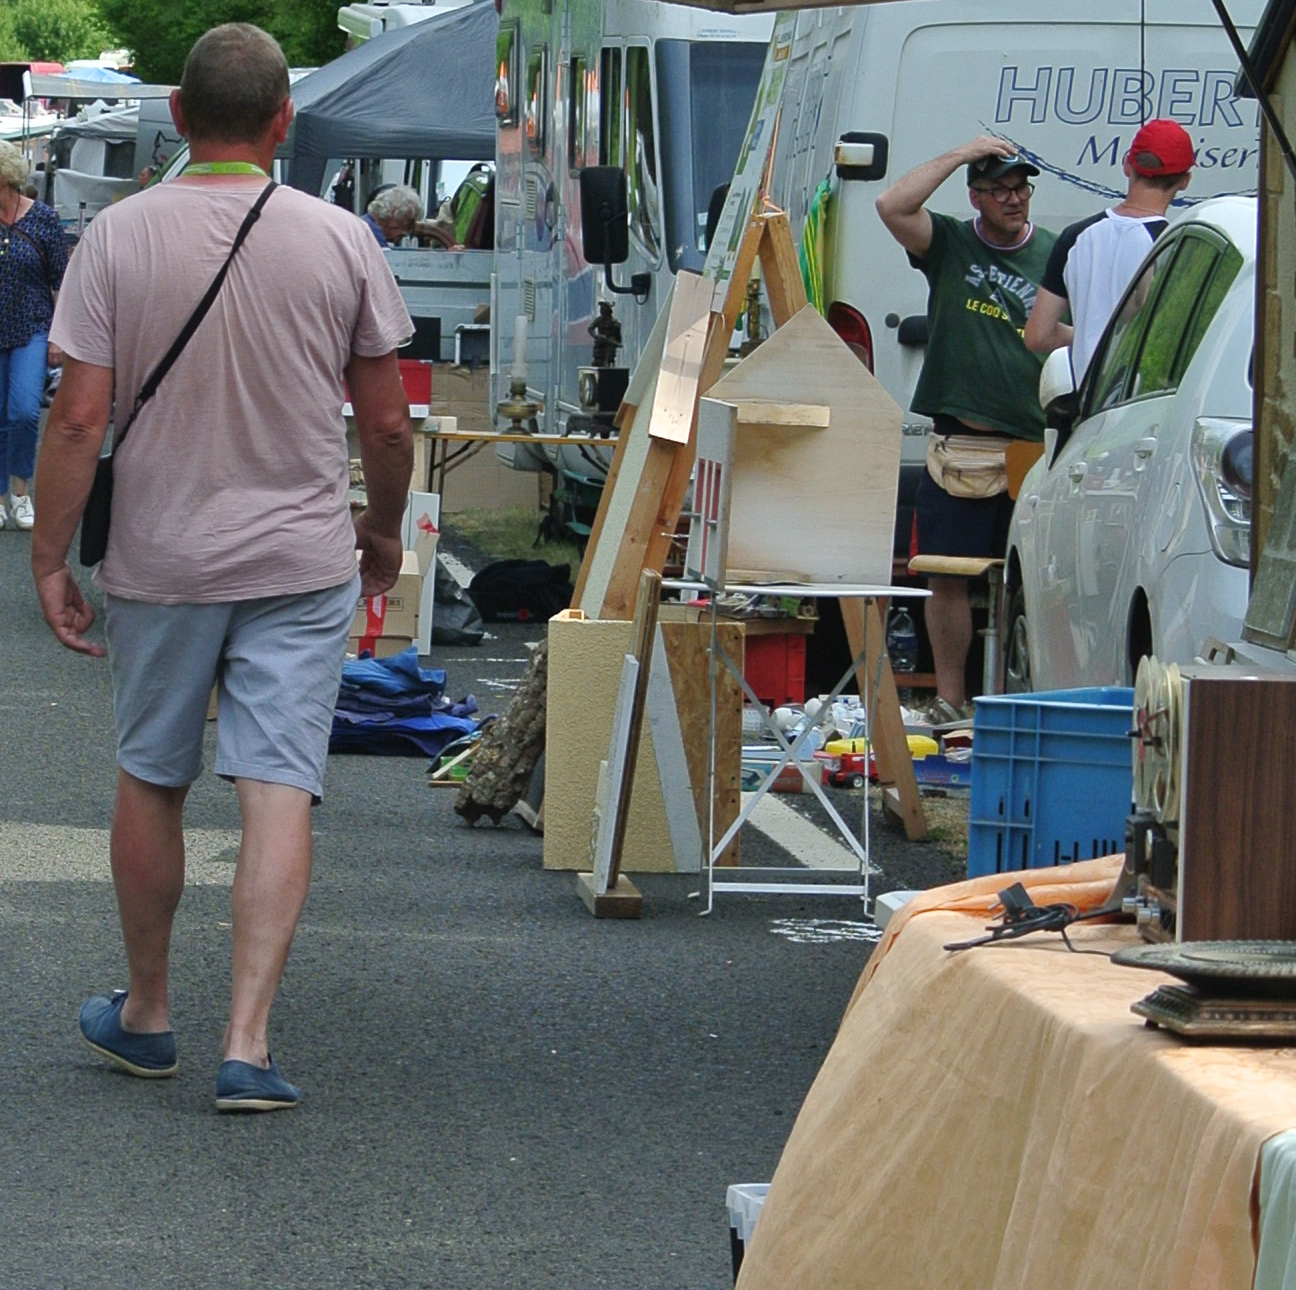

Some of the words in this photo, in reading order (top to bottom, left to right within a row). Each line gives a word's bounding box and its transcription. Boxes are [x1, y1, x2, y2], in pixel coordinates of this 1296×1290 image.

[994, 66, 1260, 127] HUBER
[1076, 134, 1259, 169] Miser
[966, 298, 980, 312] LE
